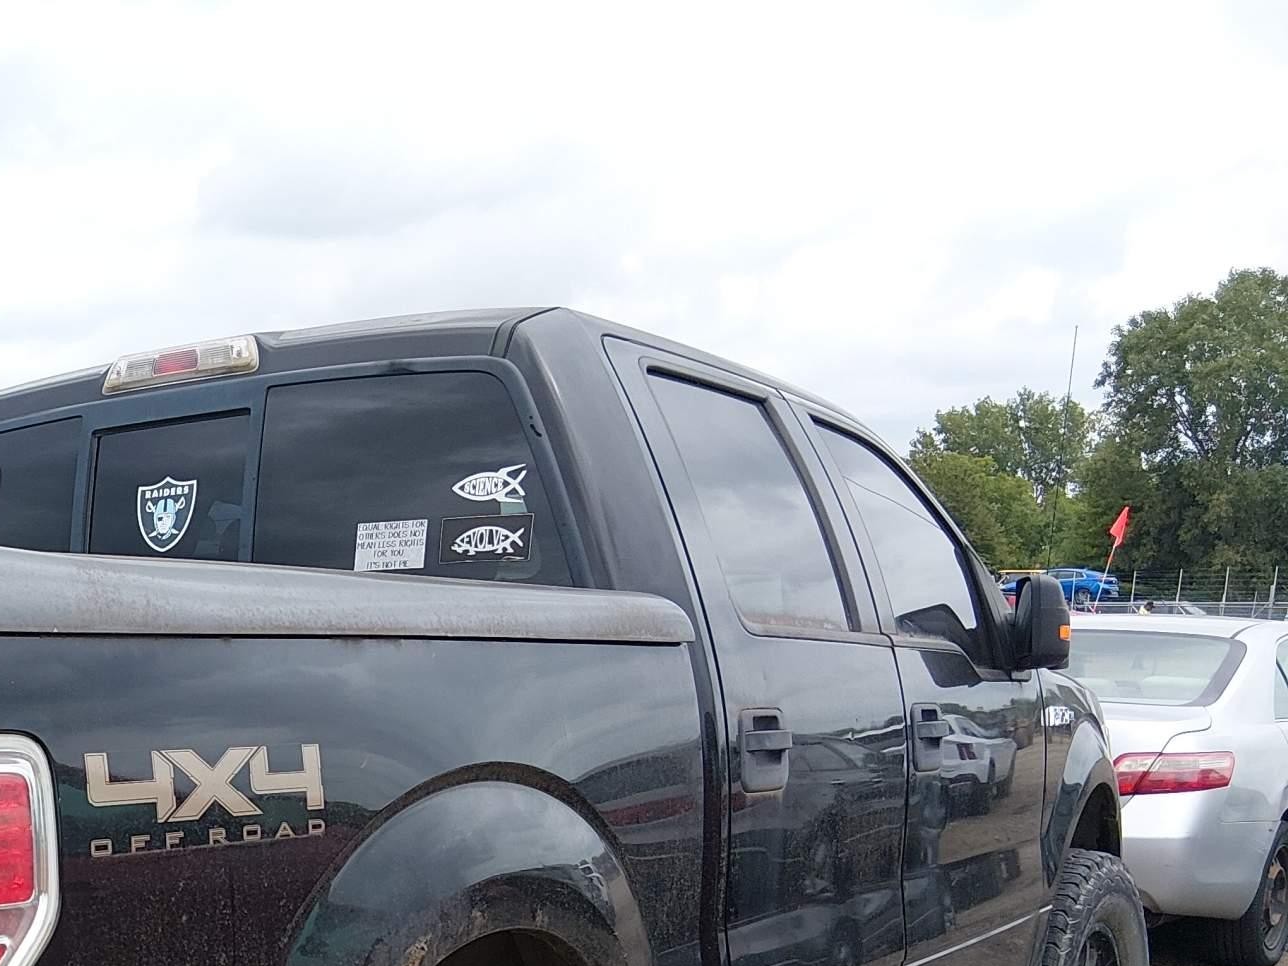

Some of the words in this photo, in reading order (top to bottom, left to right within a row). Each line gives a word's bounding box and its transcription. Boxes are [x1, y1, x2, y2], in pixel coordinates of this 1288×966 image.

[145, 486, 189, 499] RAIDERS
[463, 477, 504, 496] SCIENCE
[358, 524, 380, 532] EQUAL
[384, 521, 410, 530] RIGHTS
[411, 520, 426, 529] FOR
[358, 531, 386, 541] OTHERS
[388, 530, 408, 539] DOES
[410, 529, 425, 538] NOT
[464, 528, 507, 549] EVOLVE
[357, 541, 376, 550] MEAN
[378, 540, 397, 549] LESS
[399, 539, 425, 548] RIGHTS
[373, 550, 388, 559] FOR
[366, 561, 380, 570] IT'S
[382, 560, 397, 569] NOT
[90, 831, 186, 858] OFF
[208, 818, 326, 847] ROAD
